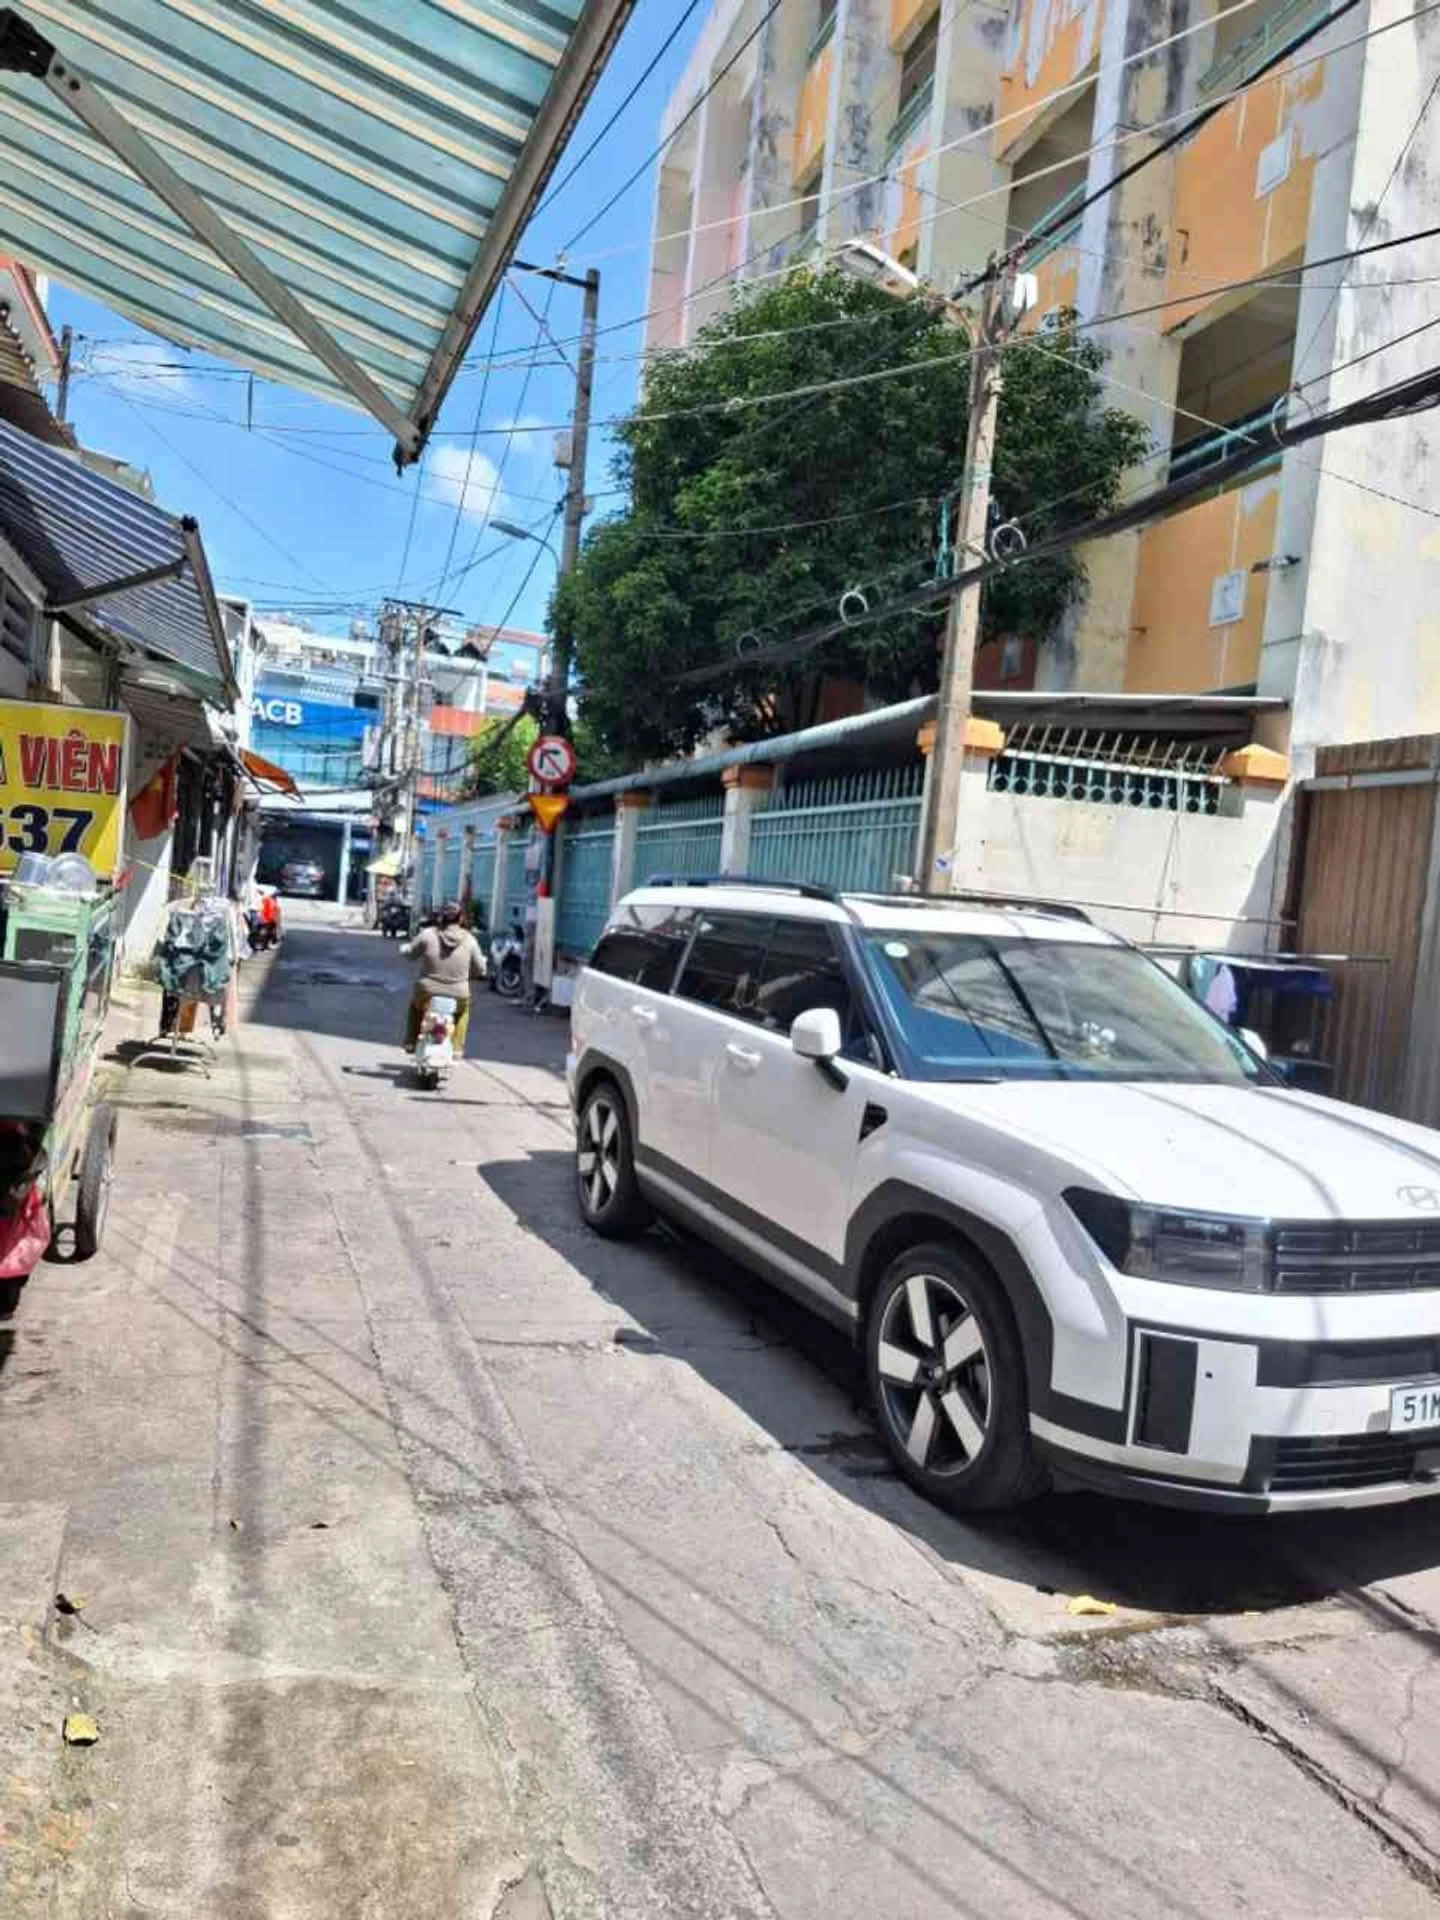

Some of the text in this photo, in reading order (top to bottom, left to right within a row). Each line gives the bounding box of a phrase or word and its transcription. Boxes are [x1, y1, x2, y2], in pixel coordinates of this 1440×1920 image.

[249, 697, 304, 726] ACB
[19, 729, 123, 795] VIÊN
[0, 803, 94, 854] 37
